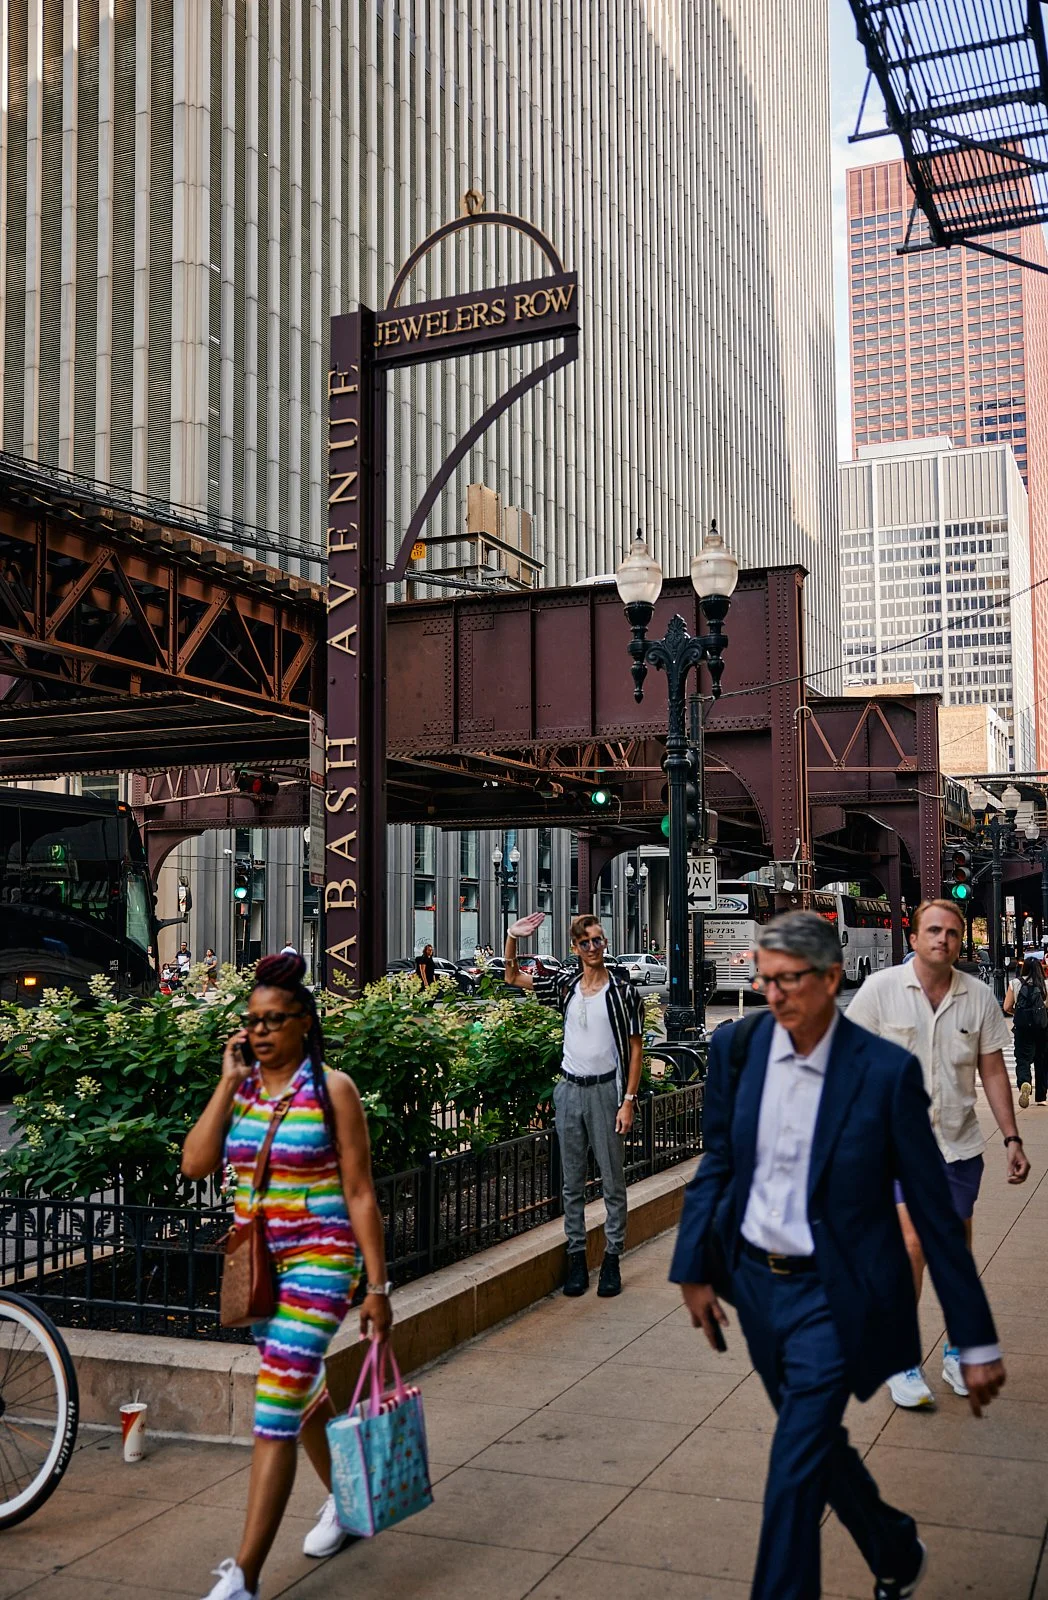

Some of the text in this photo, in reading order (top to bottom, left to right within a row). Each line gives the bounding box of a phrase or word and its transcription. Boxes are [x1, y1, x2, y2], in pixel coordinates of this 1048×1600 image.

[373, 284, 575, 347] JEWELERS ROW
[327, 364, 359, 656] AVENUE
[687, 862, 711, 875] NE
[687, 876, 712, 890] AY
